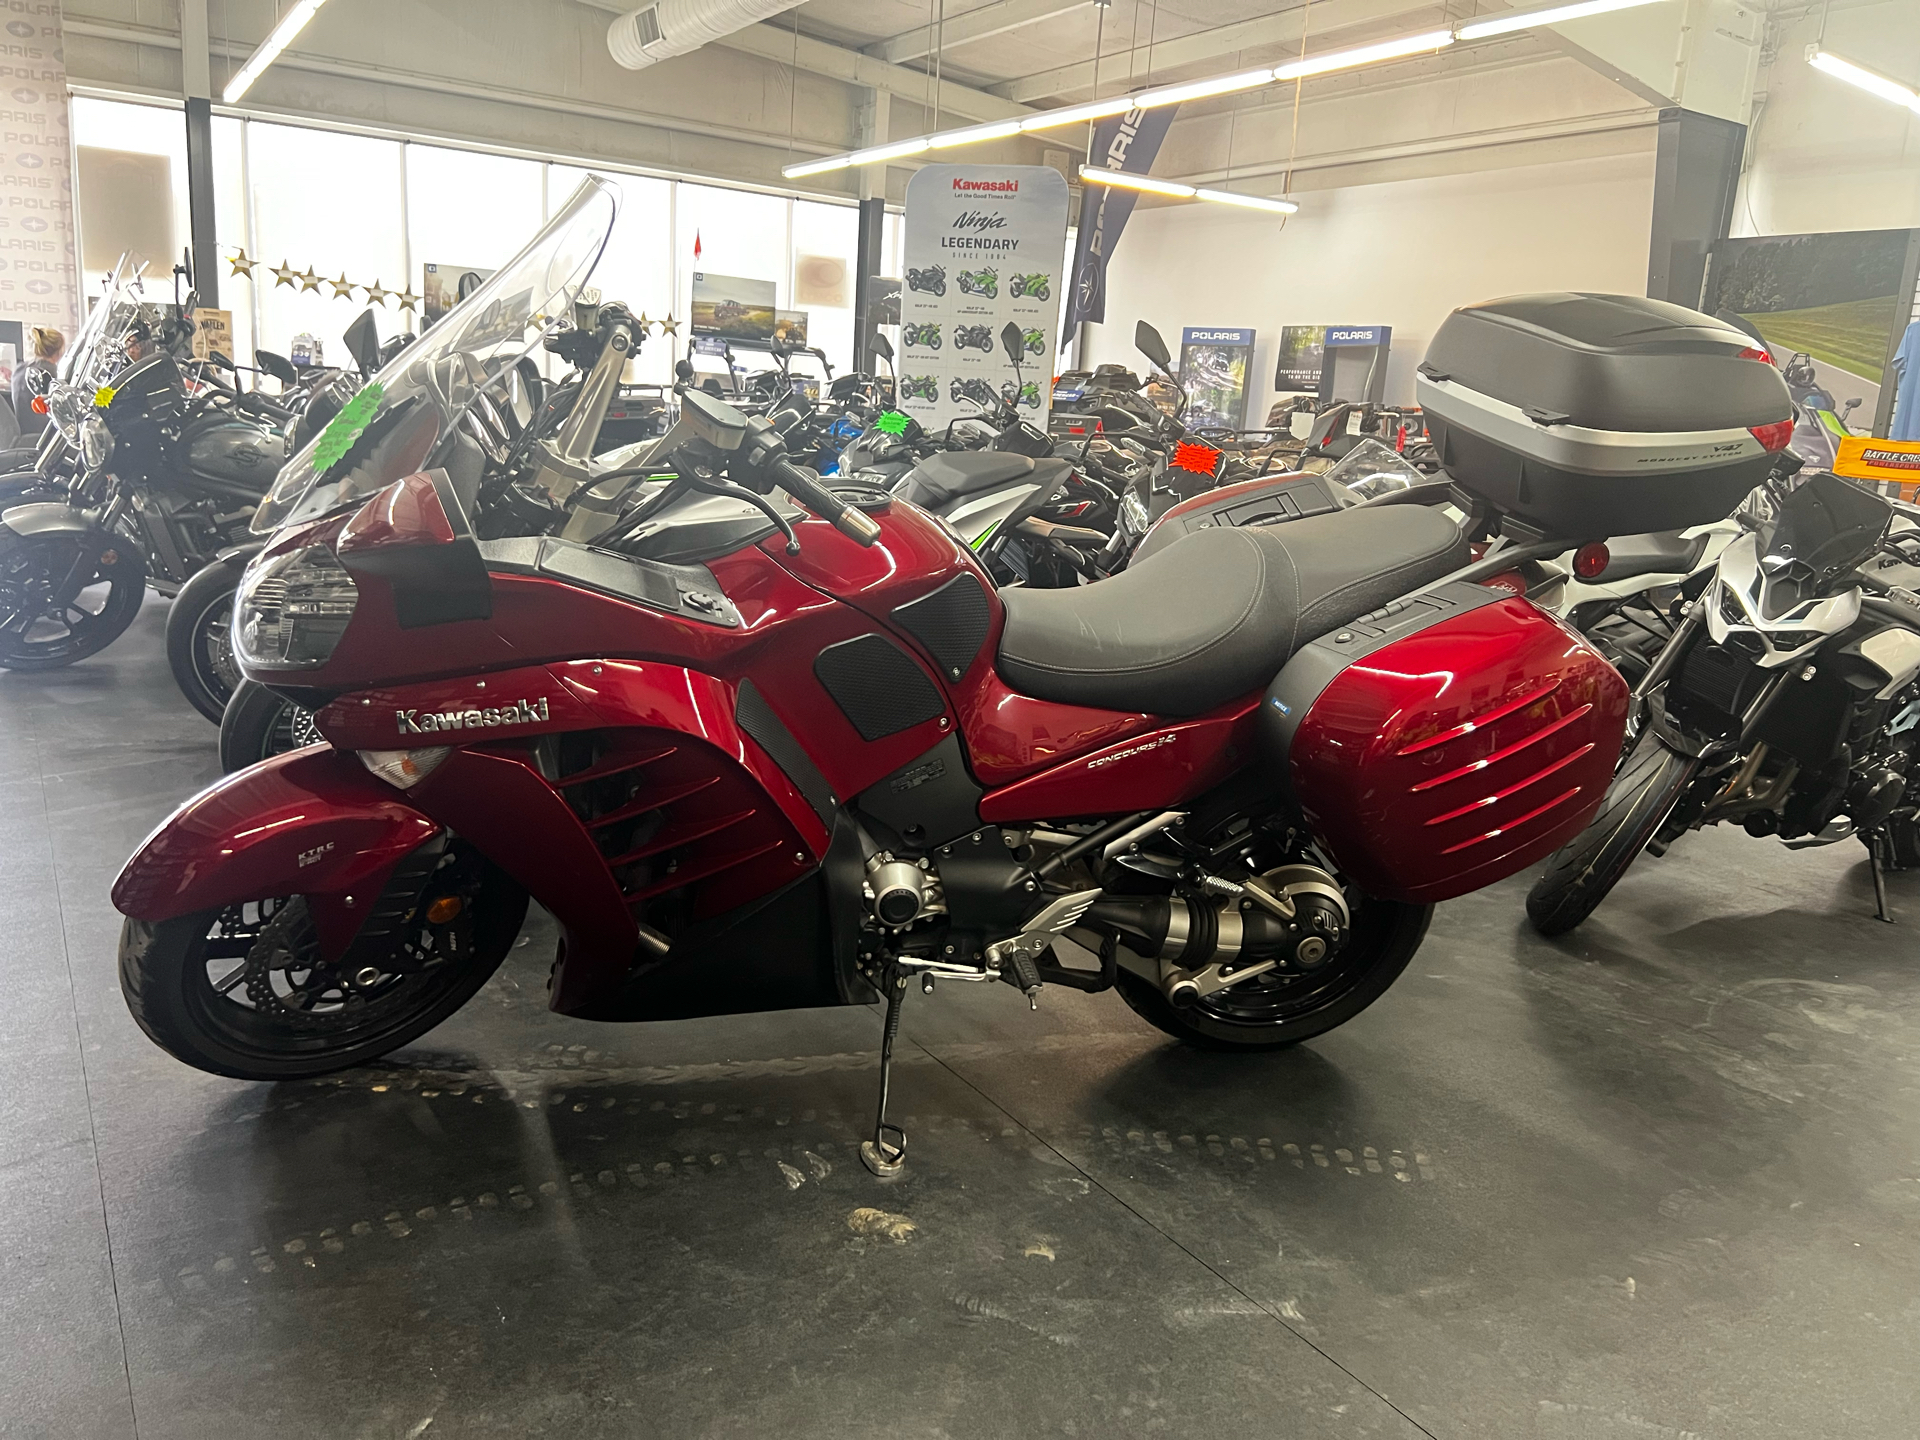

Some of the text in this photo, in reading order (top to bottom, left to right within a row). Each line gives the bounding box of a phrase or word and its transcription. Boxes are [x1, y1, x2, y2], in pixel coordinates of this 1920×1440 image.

[952, 178, 1019, 192] Kawasaki
[952, 210, 1008, 235] Ninja
[941, 236, 1020, 251] LEGENDARY
[952, 252, 979, 260] SINCE
[1191, 331, 1241, 341] POLARIS
[1332, 331, 1373, 340] POLARIS
[1714, 443, 1744, 452] V47
[1863, 449, 1900, 461] BATTLE
[396, 697, 549, 734] Kawasaki
[298, 841, 335, 860] KTRC
